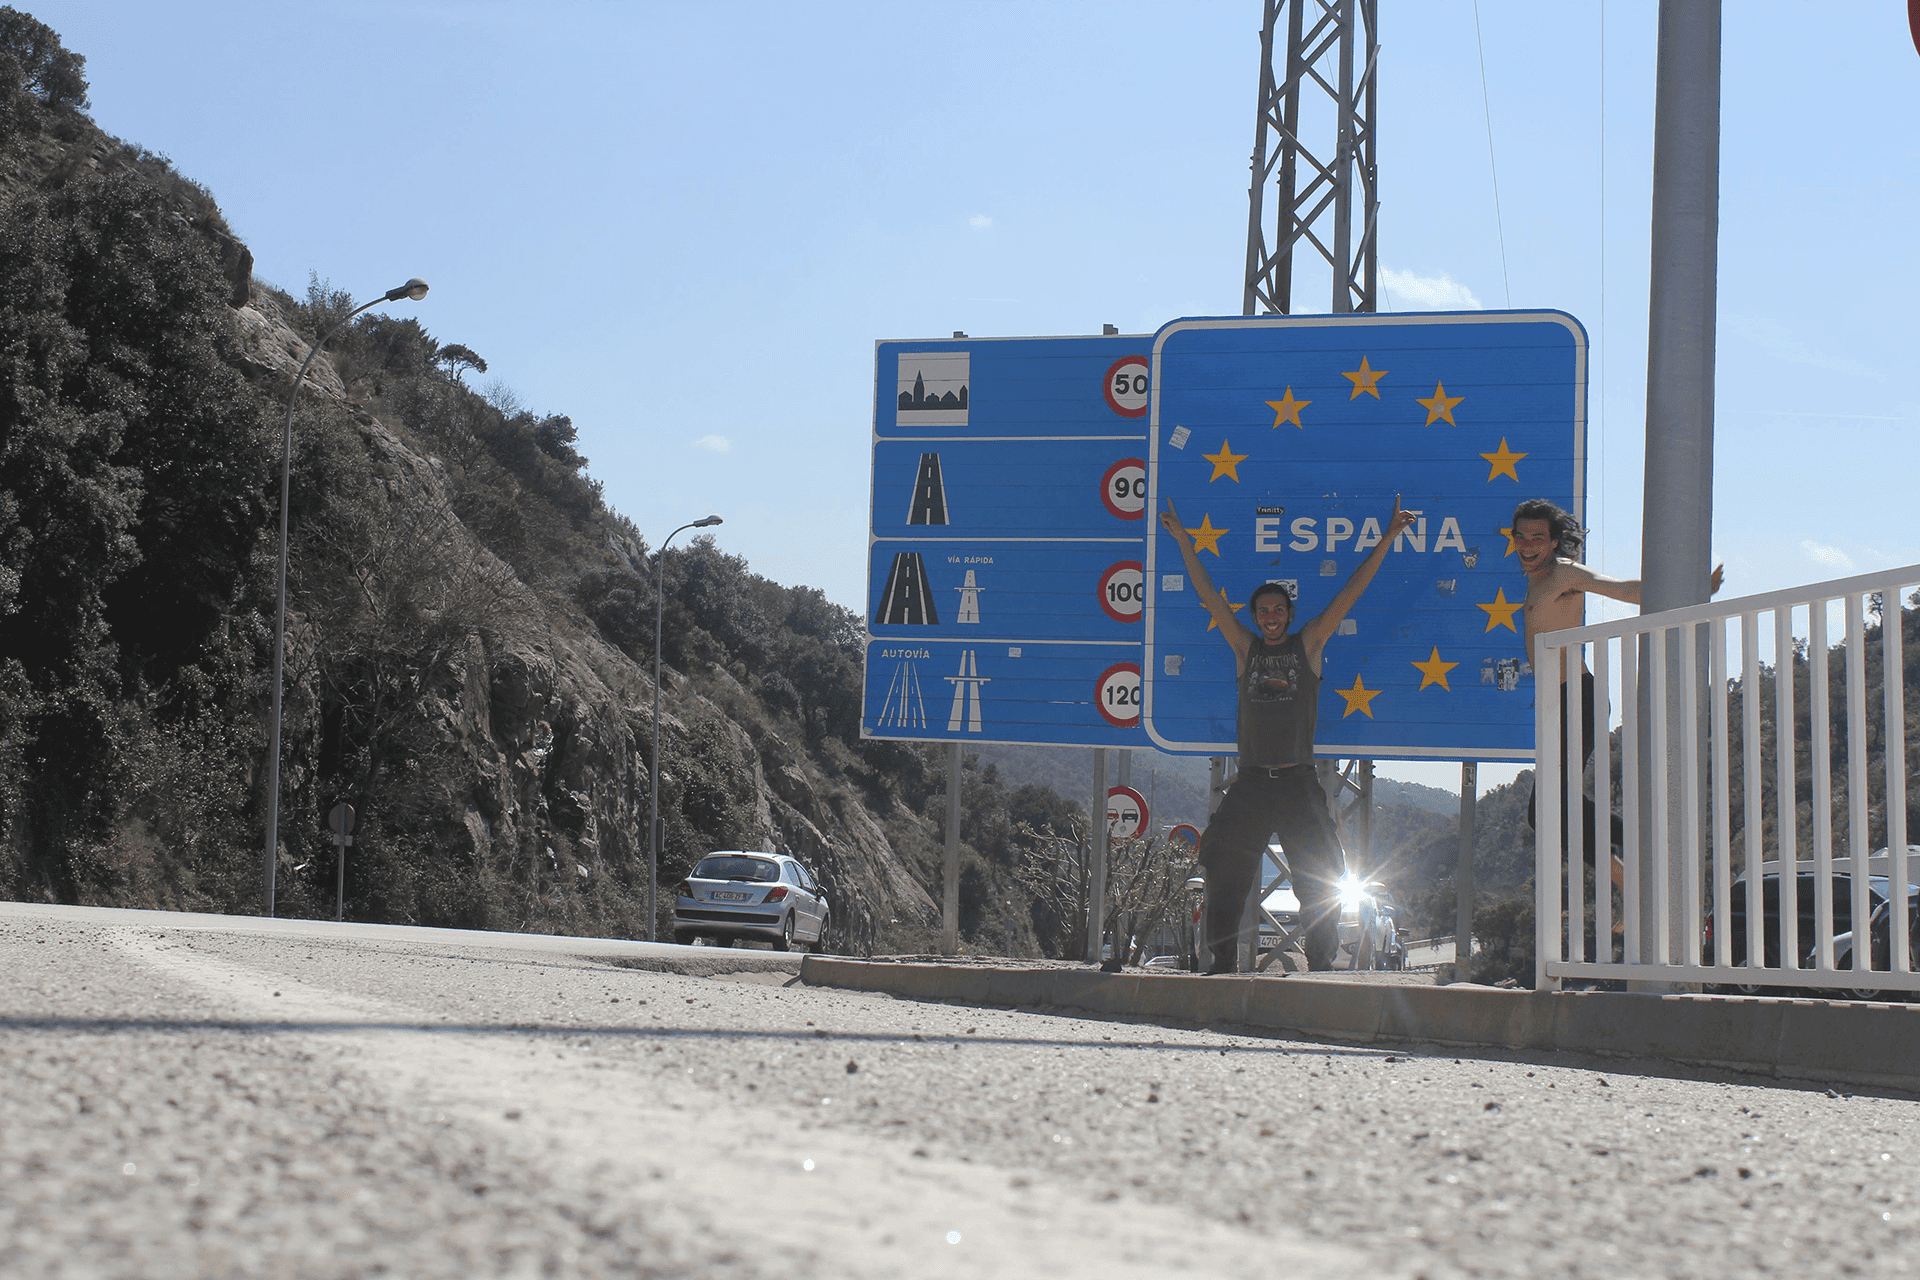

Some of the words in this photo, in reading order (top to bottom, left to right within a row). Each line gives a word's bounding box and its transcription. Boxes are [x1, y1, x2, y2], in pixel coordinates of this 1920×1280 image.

[1115, 373, 1148, 395] 50
[1114, 477, 1146, 499] 90
[1255, 510, 1467, 553] ESPAÑA
[947, 555, 961, 564] VÍA
[964, 555, 994, 564] RÁPIDA
[1107, 582, 1143, 603] 100
[881, 647, 931, 659] AUTOVÍA
[1106, 685, 1140, 706] 120
[1261, 937, 1283, 947] 470
